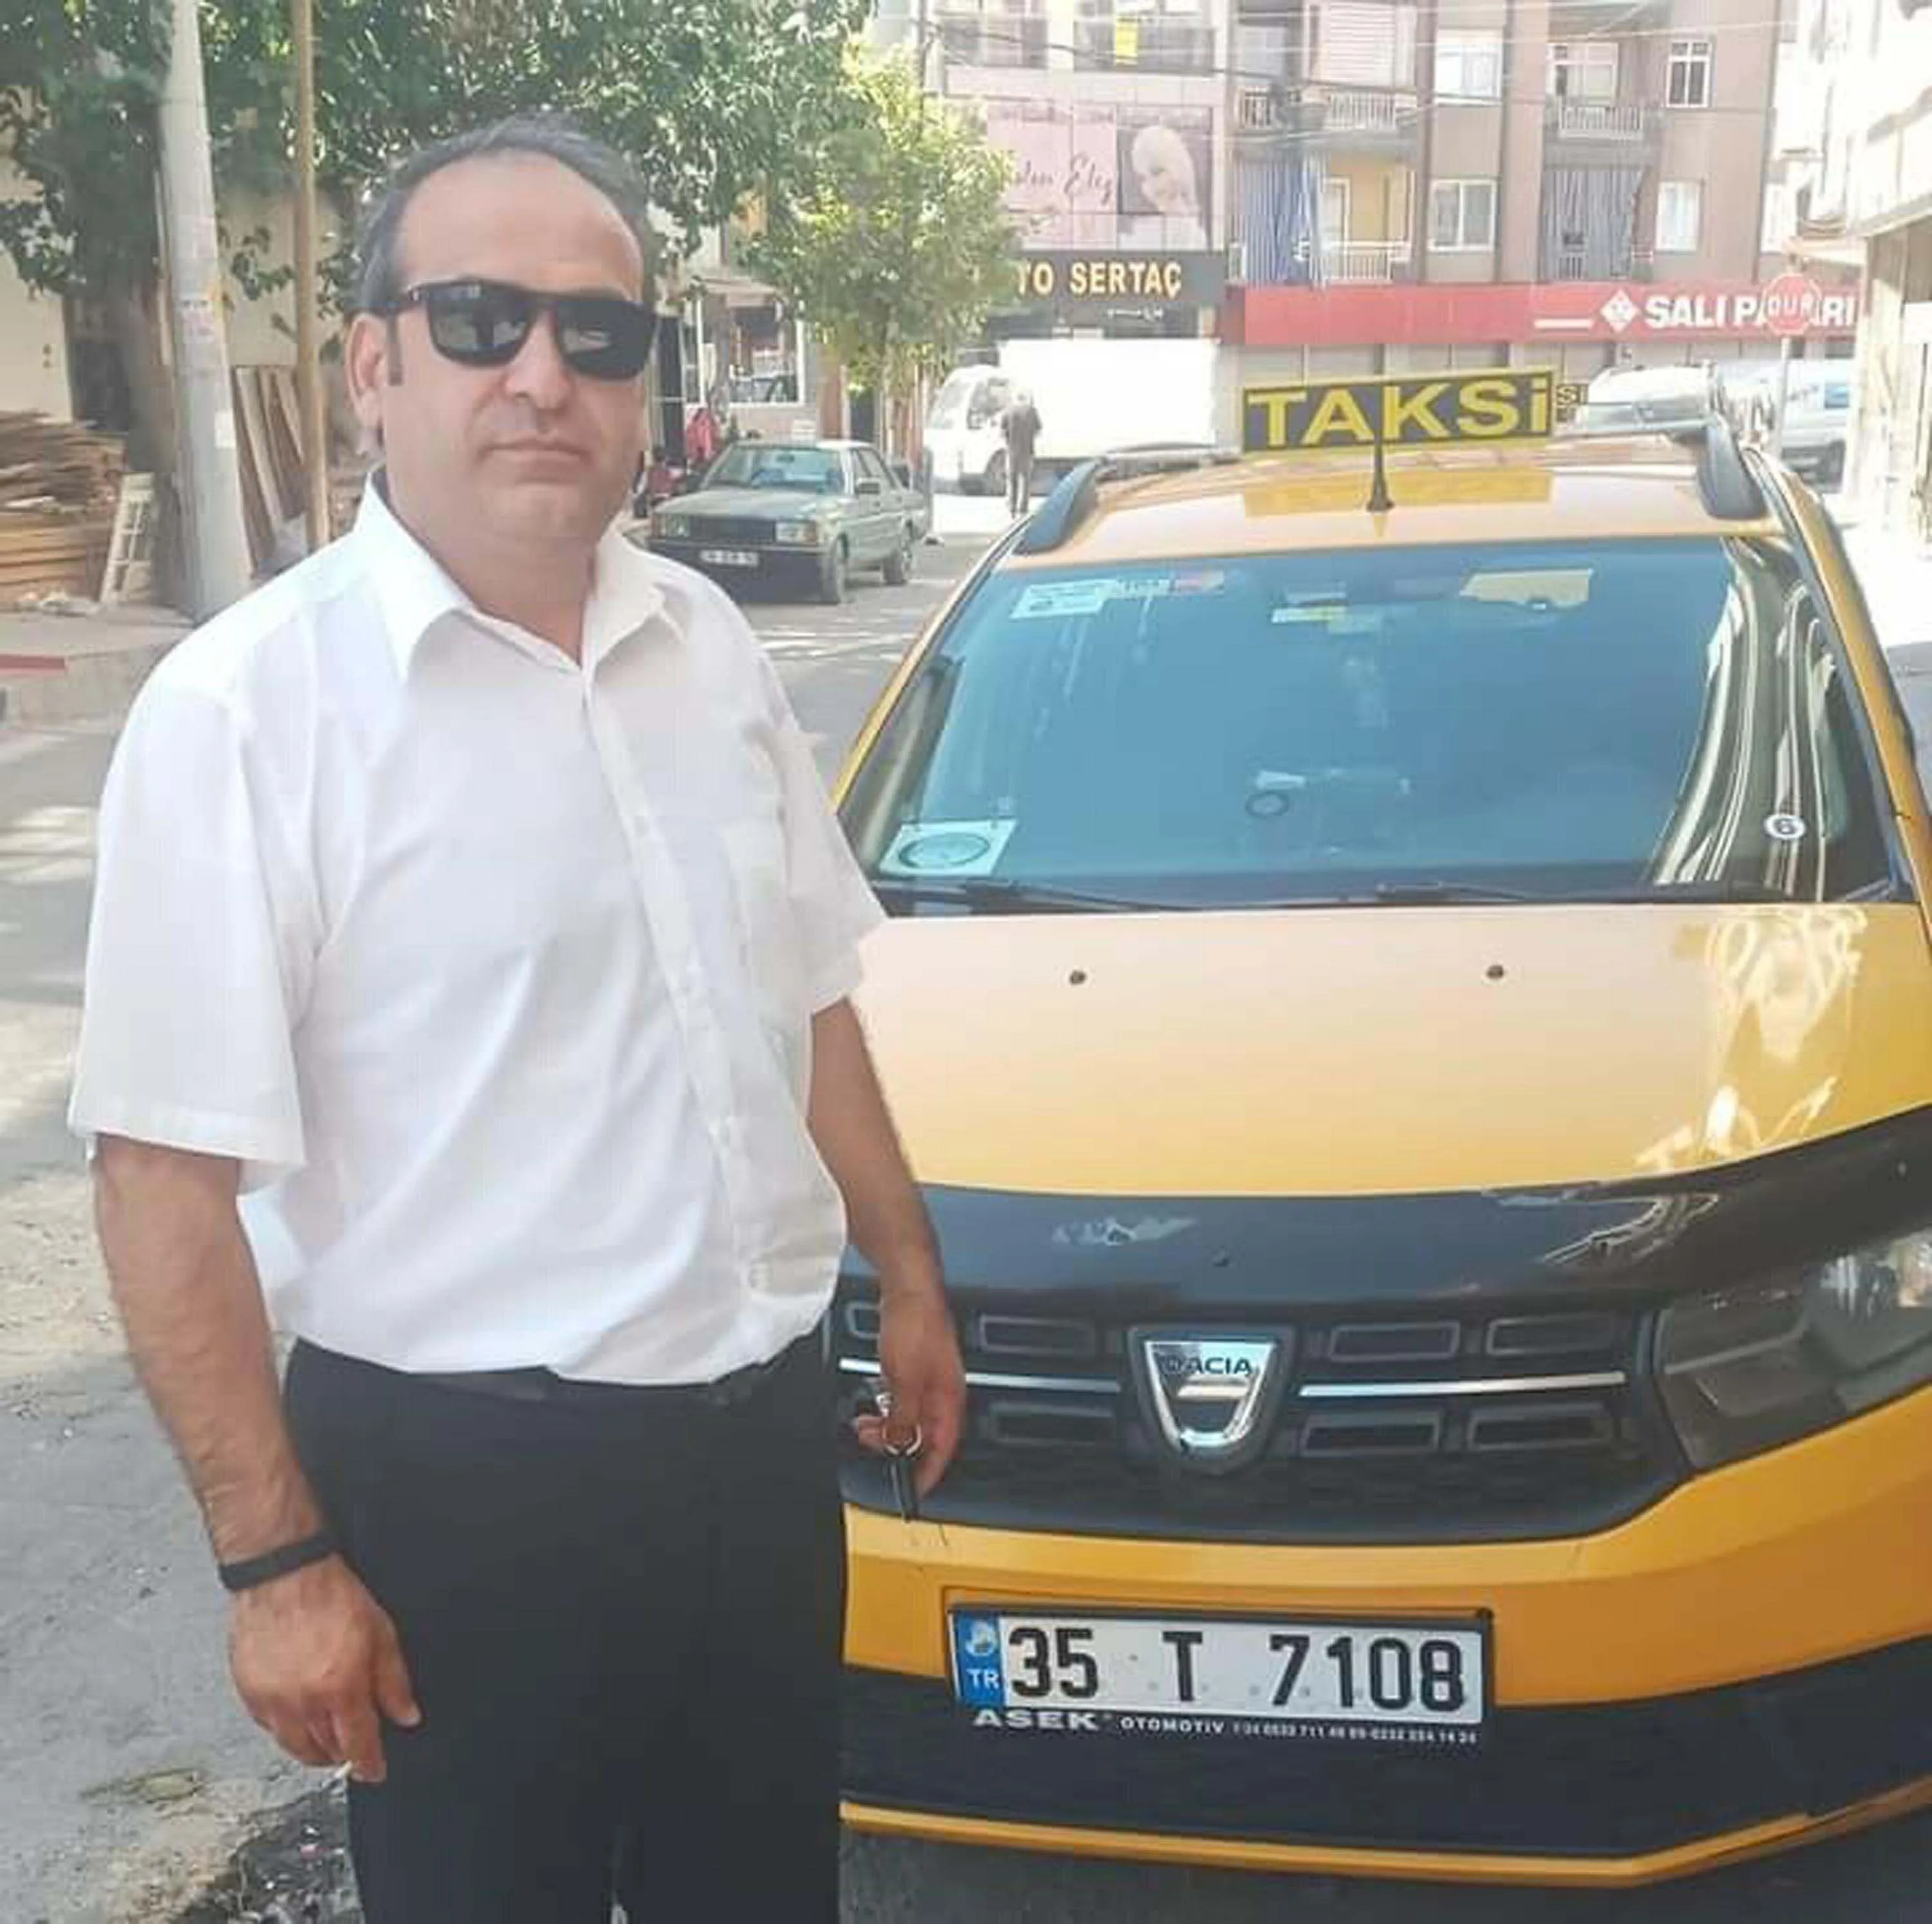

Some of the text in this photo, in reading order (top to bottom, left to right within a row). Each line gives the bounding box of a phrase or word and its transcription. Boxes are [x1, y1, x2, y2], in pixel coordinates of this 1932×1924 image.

[1070, 261, 1182, 299] SERTAÇ
[1161, 1356, 1253, 1375] DACIA
[966, 1668, 999, 1689] TR
[1009, 1627, 1464, 1712] 35 T 7108
[972, 1708, 1098, 1731] ASEK
